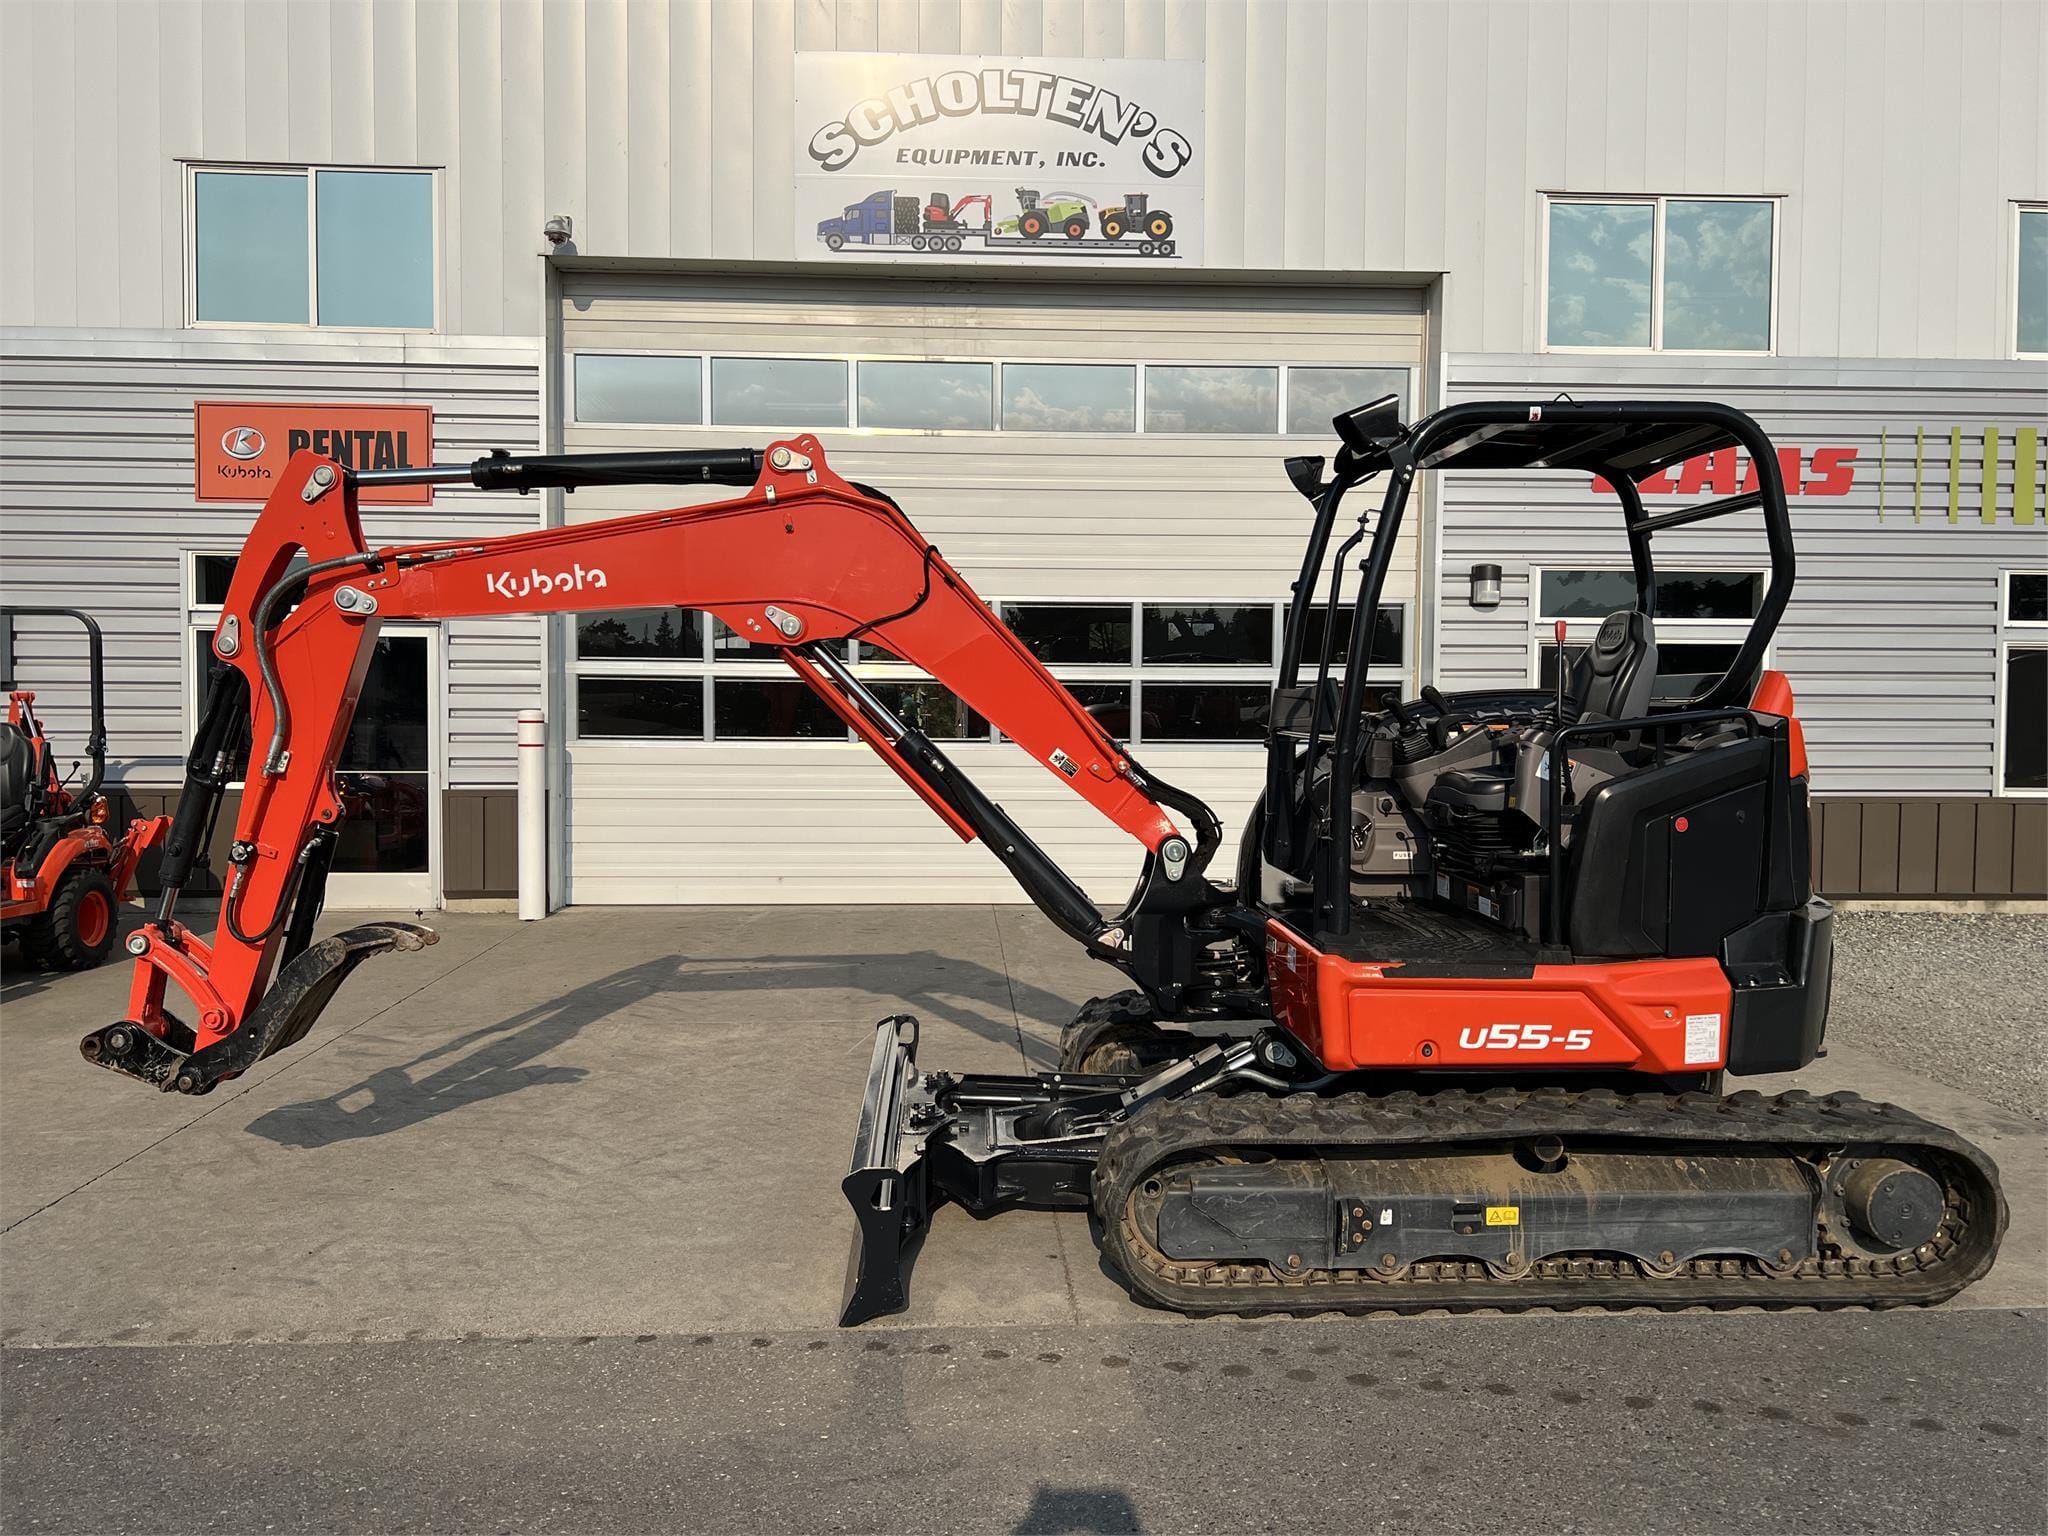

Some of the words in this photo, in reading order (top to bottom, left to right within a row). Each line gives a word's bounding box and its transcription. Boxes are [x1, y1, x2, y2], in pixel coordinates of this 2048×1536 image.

[808, 69, 1192, 178] SCHOLTEN'S
[896, 148, 1045, 168] EQUIPMENT,
[1057, 151, 1105, 167] INC.
[217, 465, 271, 479] Kubota
[486, 563, 608, 599] Kubota
